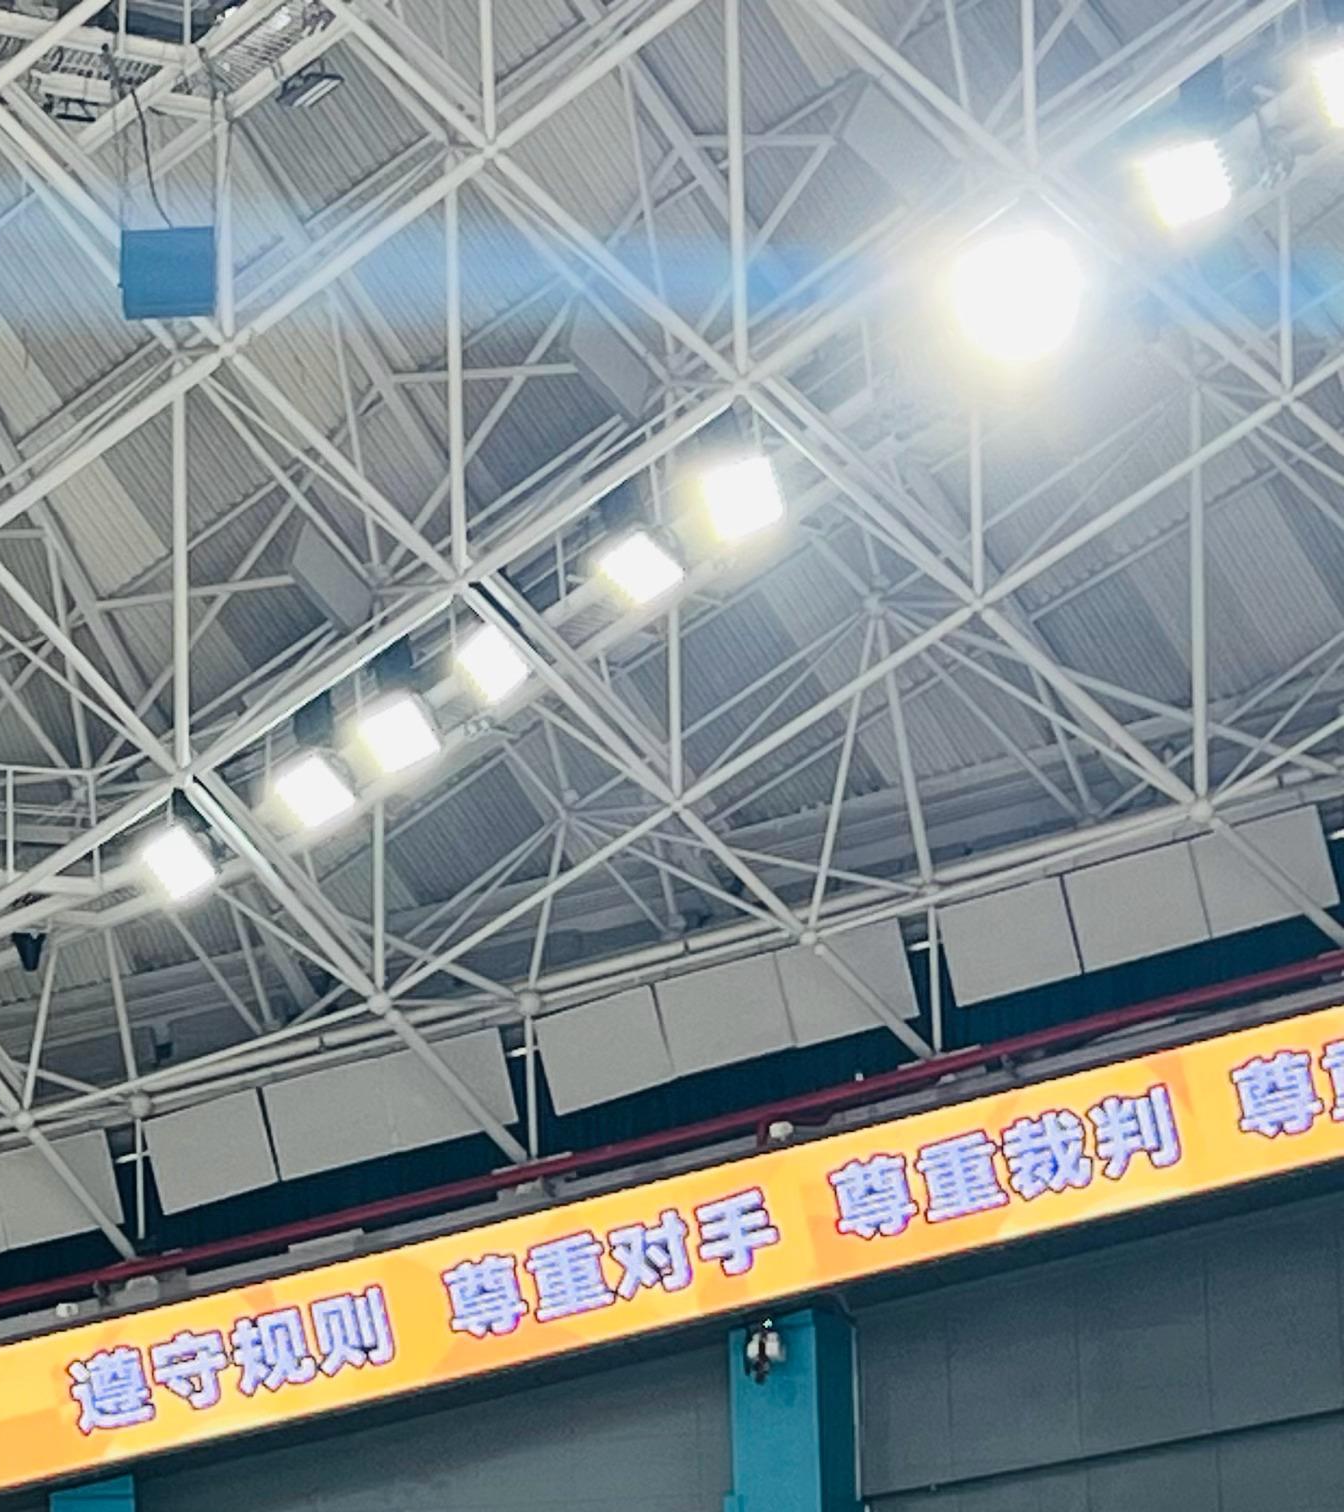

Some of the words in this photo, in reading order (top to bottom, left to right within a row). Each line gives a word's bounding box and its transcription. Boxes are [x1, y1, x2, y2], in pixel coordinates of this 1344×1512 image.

[68, 1287, 394, 1434] 遵守规则
[442, 1188, 780, 1337] 尊重对手
[828, 1083, 1182, 1239] 尊重裁判
[1231, 1040, 1344, 1139] 尊
